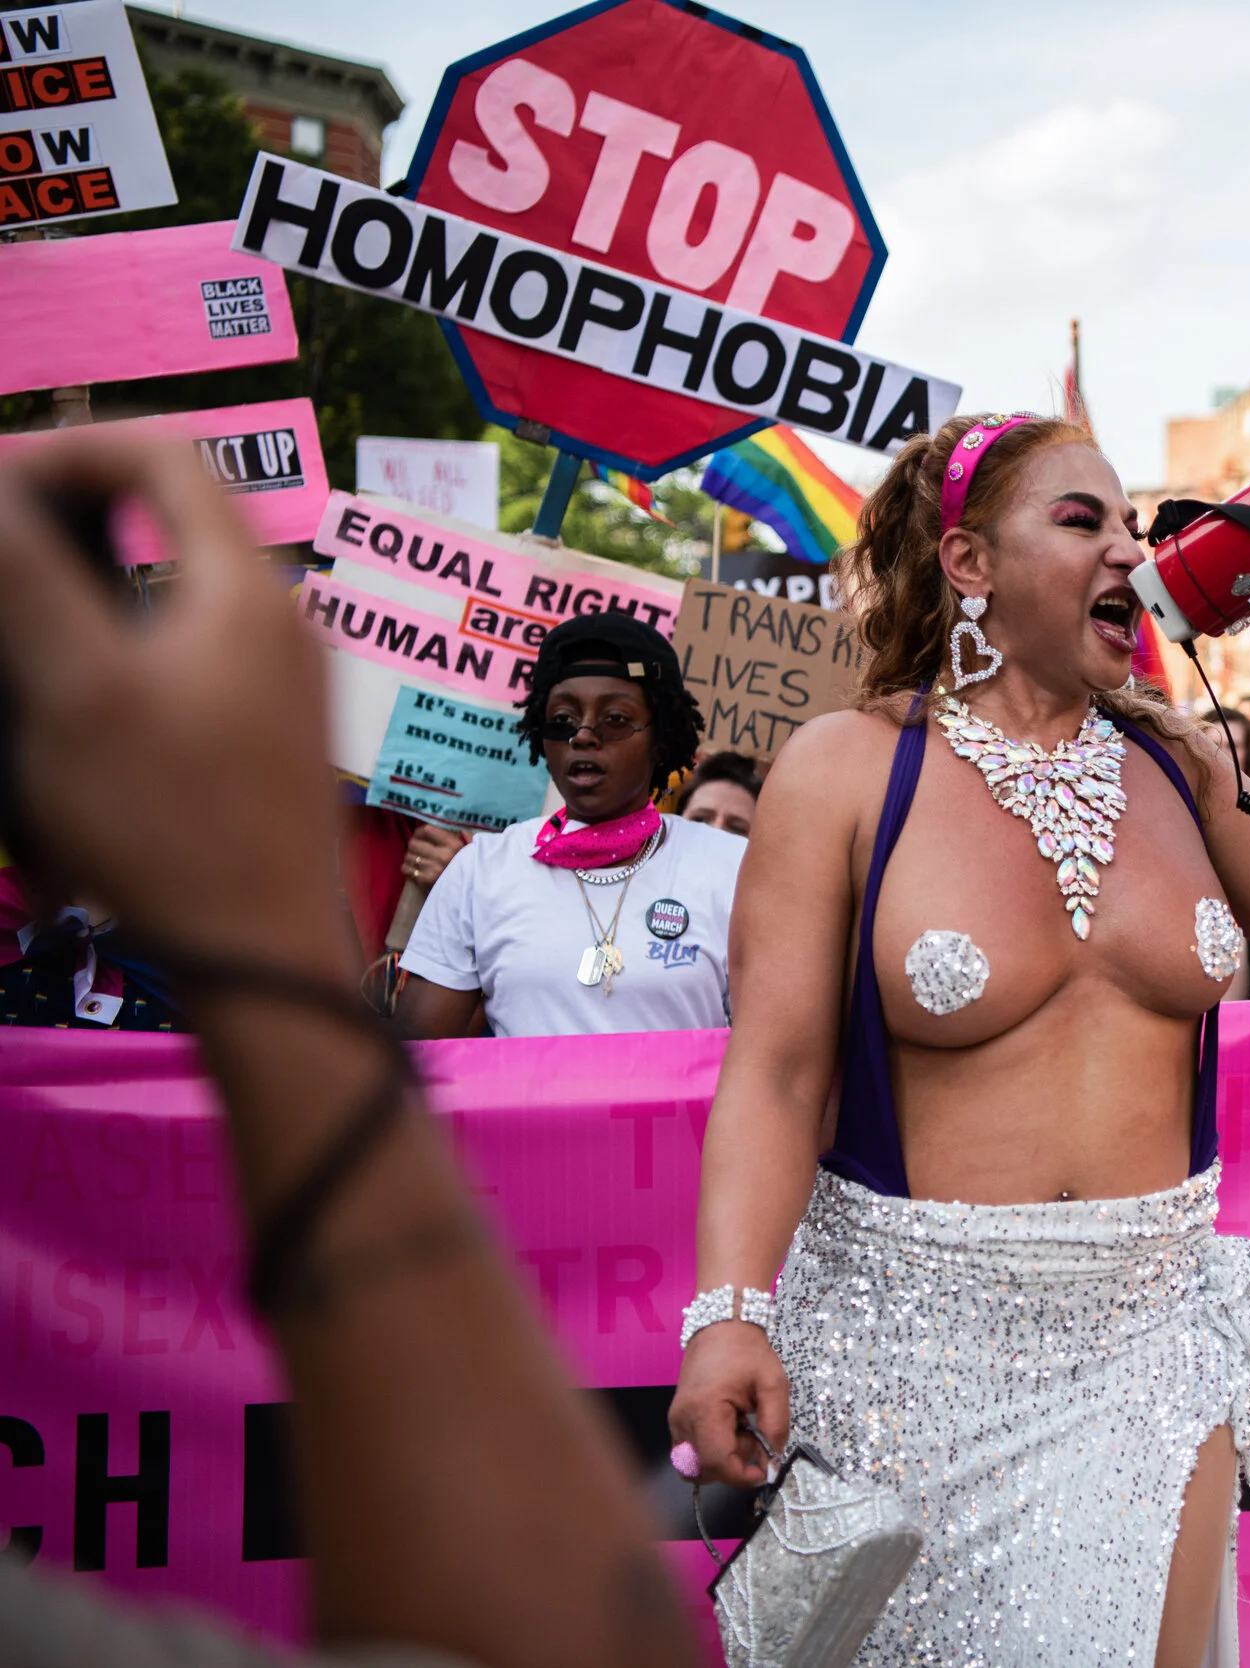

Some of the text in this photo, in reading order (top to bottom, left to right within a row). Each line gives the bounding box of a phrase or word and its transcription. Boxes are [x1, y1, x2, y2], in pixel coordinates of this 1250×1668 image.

[0, 15, 60, 54] W
[7, 61, 112, 108] ICE
[448, 58, 855, 316] STOP
[203, 278, 261, 298] BLACK
[208, 299, 265, 317] LIVES
[242, 161, 930, 451] HOMOPHOBIA
[210, 317, 269, 337] MATTER
[200, 431, 294, 481] ACT UP
[335, 508, 503, 598] EQUAL
[304, 587, 494, 681] HUMAN
[470, 605, 548, 647] are
[694, 591, 827, 655] TRANS
[682, 644, 810, 707] LIVES
[414, 692, 456, 718] It's
[462, 711, 505, 732] not
[405, 724, 518, 765] moment,
[394, 760, 457, 790] it's a
[386, 790, 518, 828] movement
[651, 919, 683, 933] MARCH
[655, 902, 685, 917] QUEER
